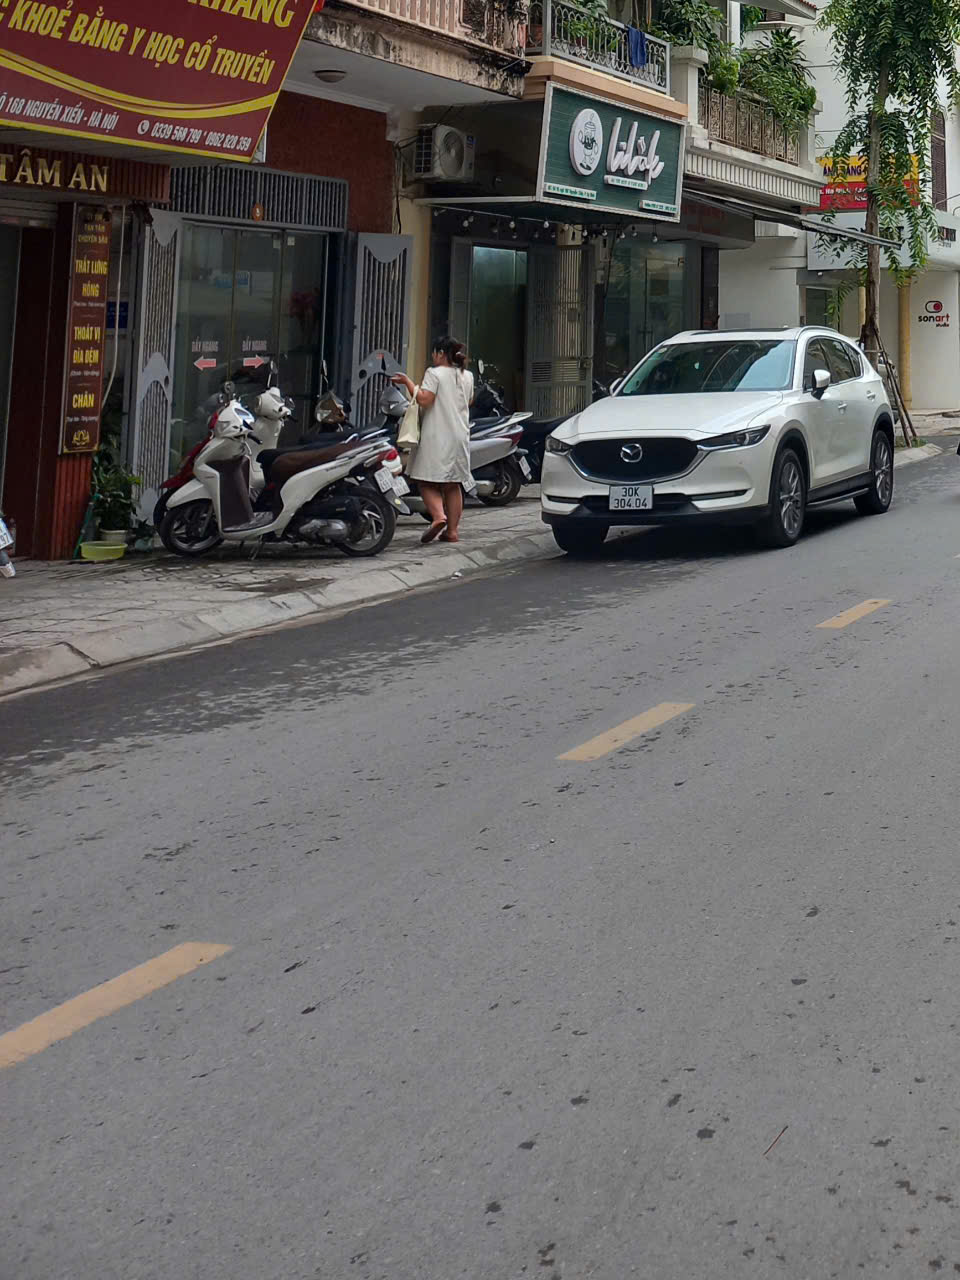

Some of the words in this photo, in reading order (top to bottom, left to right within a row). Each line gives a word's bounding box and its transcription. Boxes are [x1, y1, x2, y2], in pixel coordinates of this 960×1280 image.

[68, 6, 129, 52] BẰNG
[128, 26, 147, 56] Y
[142, 31, 185, 68] HỌC
[184, 35, 218, 71] CỔ
[211, 48, 276, 85] TRUYỀN
[5, 97, 25, 114] 168
[88, 109, 103, 128] HÀ
[101, 112, 119, 133] NỘI
[151, 122, 174, 139] 0339
[186, 129, 202, 144] 799
[0, 148, 60, 187] TÂM
[68, 163, 109, 193] AN
[918, 313, 950, 323] sonart
[74, 324, 94, 340] THOÁT
[94, 326, 101, 343] VỊ
[85, 346, 99, 366] ĐỆM
[72, 391, 95, 408] CHÂN
[622, 487, 640, 497] 30K
[614, 498, 647, 508] 304.04
